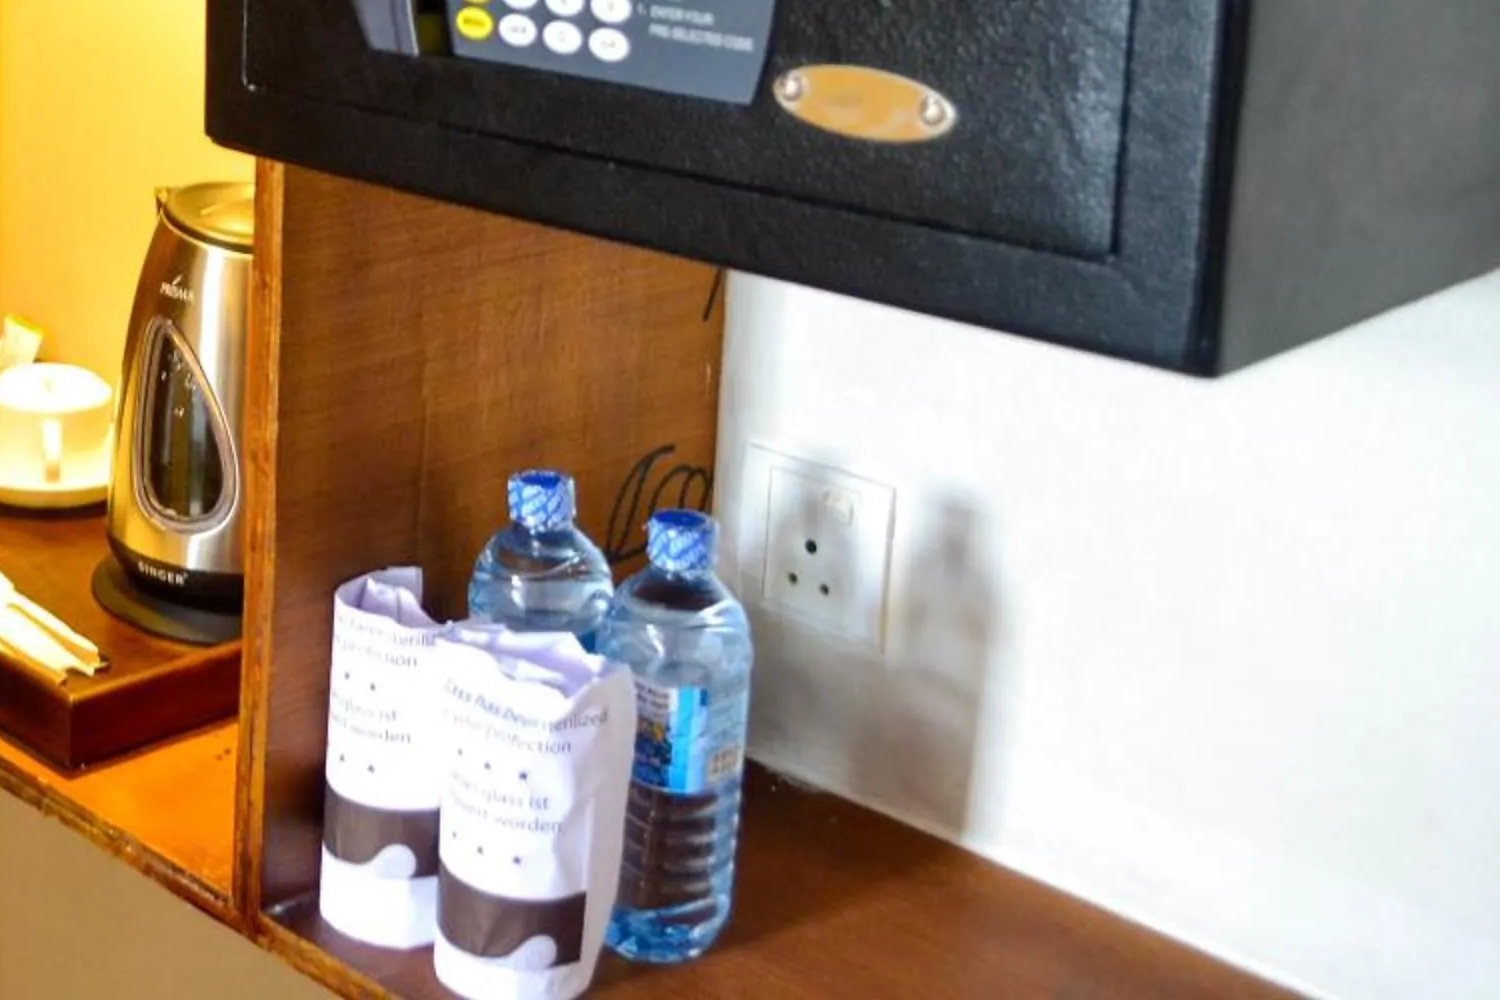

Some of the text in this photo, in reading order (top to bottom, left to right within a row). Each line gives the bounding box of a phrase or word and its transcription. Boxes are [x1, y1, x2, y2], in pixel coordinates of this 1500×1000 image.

[137, 560, 185, 586] SINGER
[474, 694, 500, 717] has
[541, 703, 610, 734] sterilized
[528, 796, 549, 812] ist
